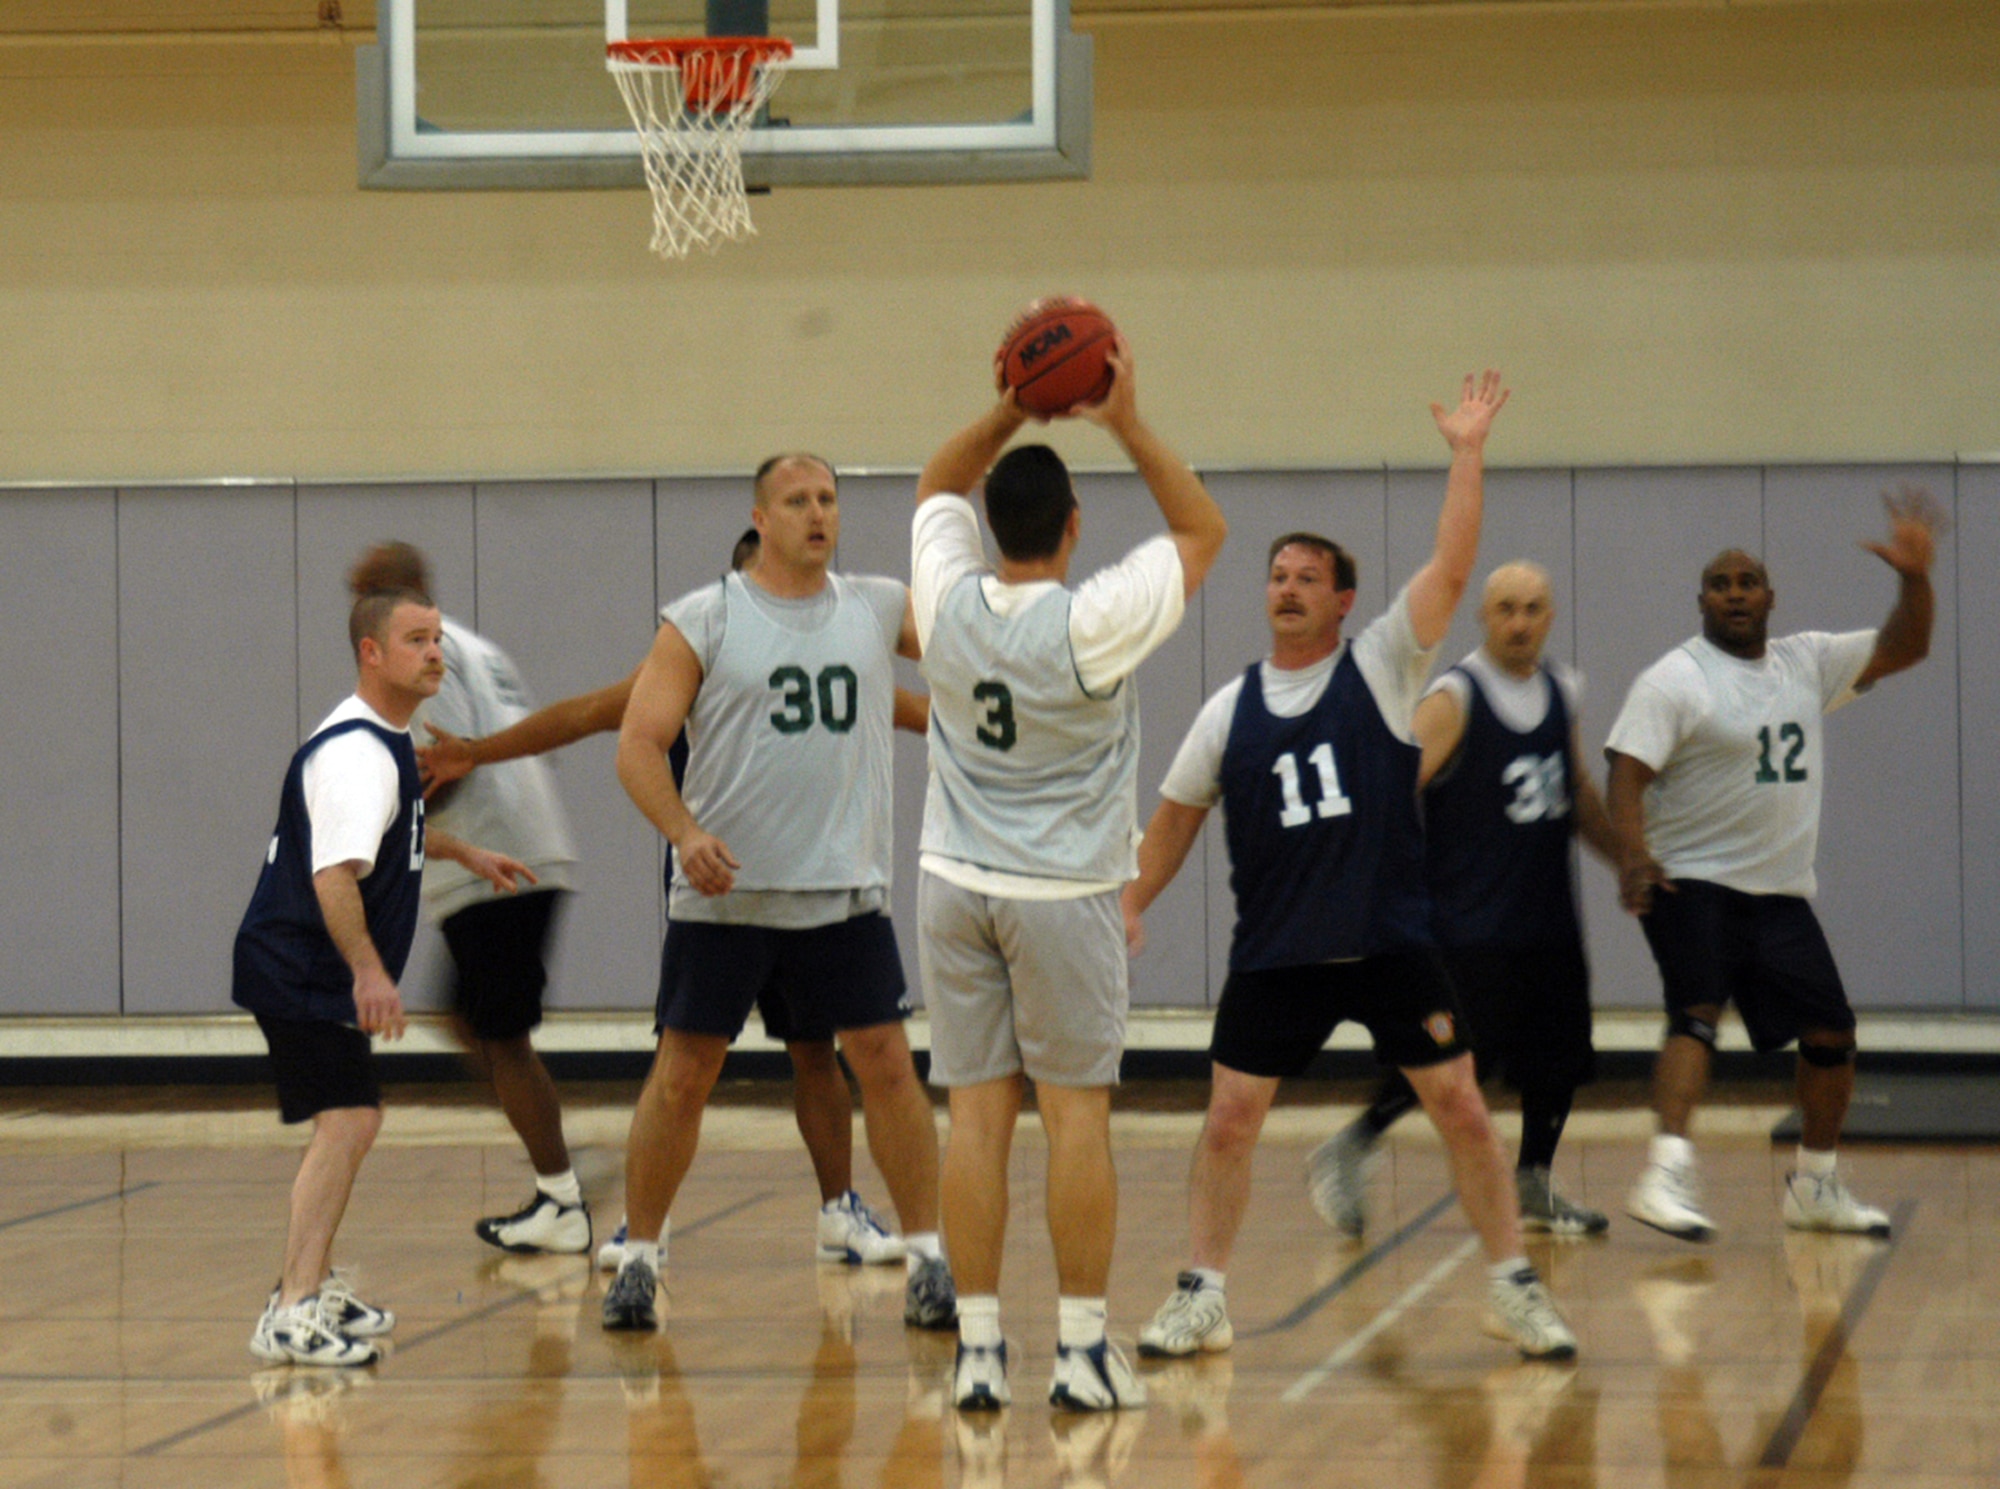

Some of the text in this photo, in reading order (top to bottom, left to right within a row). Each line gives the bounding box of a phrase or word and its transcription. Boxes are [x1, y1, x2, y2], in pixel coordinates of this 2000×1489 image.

[1019, 323, 1071, 369] NCAA
[769, 665, 857, 734] 30
[973, 681, 1017, 752] 3
[1272, 743, 1351, 828] 11
[1755, 722, 1808, 784] 12
